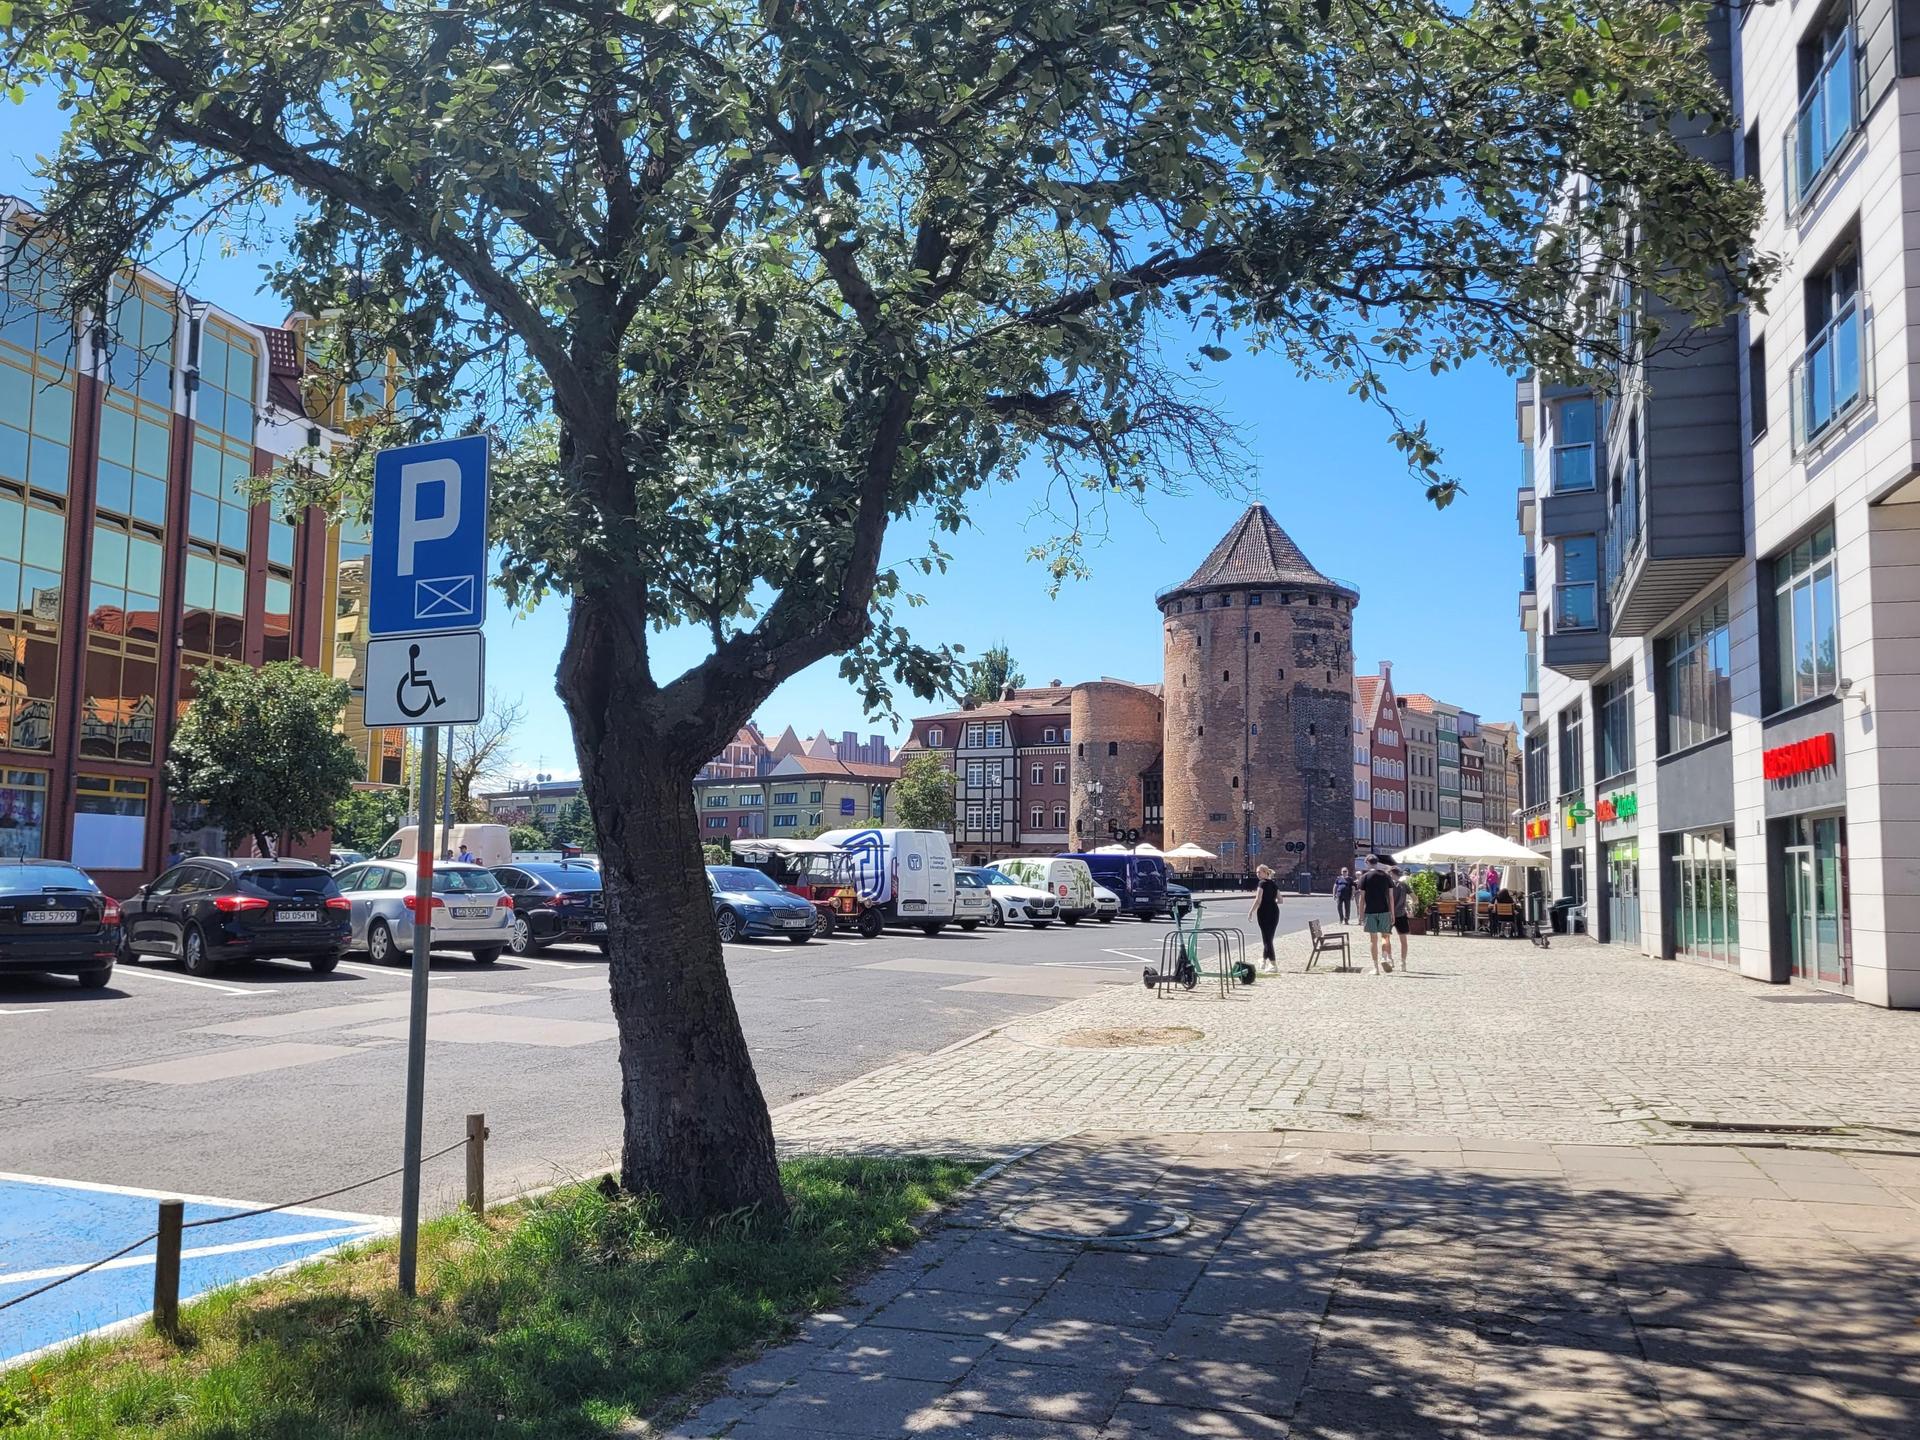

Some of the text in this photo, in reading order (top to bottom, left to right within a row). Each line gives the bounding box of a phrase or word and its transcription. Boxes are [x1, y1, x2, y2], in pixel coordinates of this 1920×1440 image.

[397, 458, 462, 577] P
[28, 911, 76, 921] NEB 57999
